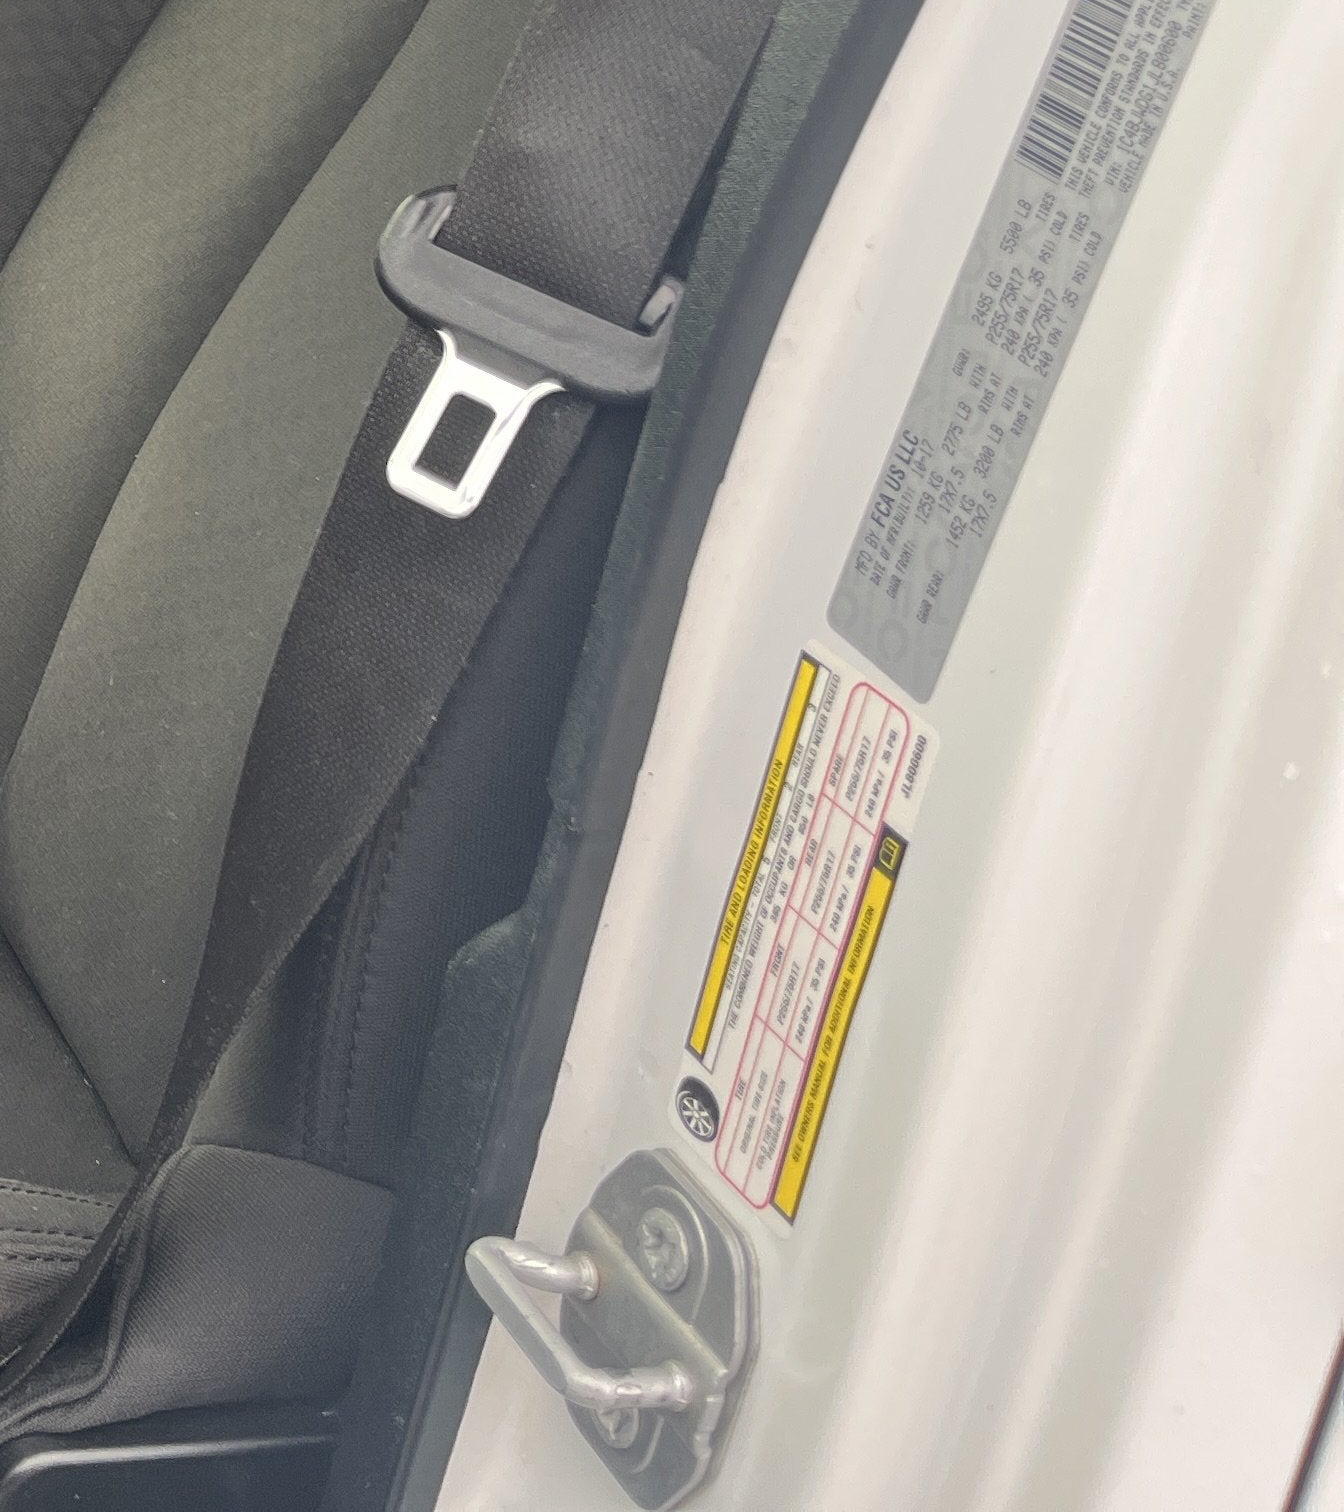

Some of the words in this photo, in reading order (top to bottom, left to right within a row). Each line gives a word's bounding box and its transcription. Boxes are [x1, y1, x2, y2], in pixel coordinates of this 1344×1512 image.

[1115, 51, 1131, 67] TO
[1121, 29, 1140, 51] ALL
[1093, 68, 1124, 120] CONFORMS
[1115, 17, 1183, 156] 1C4BJWDG1JL800600
[1077, 166, 1100, 201] THEFT
[1091, 104, 1126, 168] PREVENTION
[1117, 46, 1150, 105] STANDARDS
[1141, 29, 1157, 45] IN
[1075, 120, 1102, 165] VEHICLE
[1117, 149, 1145, 195] VEHICLE
[1135, 120, 1157, 149] MADE
[1148, 103, 1164, 119] IN
[1064, 164, 1084, 192] THIS
[970, 290, 994, 327] 2495
[984, 268, 1003, 292] KG
[998, 219, 1023, 255] 5500
[1013, 196, 1032, 219] LB
[912, 490, 936, 525] 1259
[926, 468, 945, 492] KG
[940, 420, 964, 457] 2775
[954, 399, 972, 422] LB
[967, 361, 987, 390] WITH
[984, 265, 1026, 346] P255/75R17
[1034, 189, 1056, 223] TIRES
[936, 464, 966, 514] 17X7.5
[976, 387, 996, 415] RIMS
[987, 371, 1002, 388] AT
[999, 327, 1021, 356] 240
[1013, 303, 1030, 327] KPA
[1026, 265, 1046, 289] 35
[1048, 208, 1069, 238] COLD
[944, 513, 968, 550] 1452
[957, 491, 977, 516] KG
[971, 442, 996, 480] 3200
[986, 421, 1005, 445] LB
[999, 383, 1019, 412] WITH
[1017, 286, 1060, 368] P255/75R17
[1068, 209, 1090, 244] TIRES
[968, 487, 998, 538] 17X7.5
[1009, 409, 1029, 438] RIMS
[1020, 393, 1035, 411] AT
[1032, 349, 1054, 378] 240
[1046, 325, 1063, 348] KPA
[1060, 286, 1080, 310] 35
[1082, 228, 1103, 258] COLD
[893, 427, 920, 466] LLC
[883, 462, 906, 493] US
[868, 559, 886, 587] DATE
[878, 544, 892, 561] OF
[910, 436, 936, 479] 10-17
[869, 488, 895, 529] FCA
[863, 527, 881, 550] BY
[821, 671, 841, 714] EXCEED
[811, 711, 829, 748] NEVER
[799, 745, 818, 790] SHOULD
[828, 751, 844, 788] SPARE
[788, 786, 805, 825] CARGO
[719, 914, 734, 948] TIRE
[728, 889, 742, 919] AND
[736, 835, 759, 894] LOADING
[752, 756, 784, 841] INFORMATION
[735, 907, 753, 955] CAPACITY
[751, 869, 765, 900] TOTAL
[769, 811, 783, 844] FRONT
[791, 741, 804, 769] REAR
[782, 822, 795, 846] AND
[804, 836, 818, 867] REAR
[764, 843, 788, 907] OCCUPANTS
[786, 853, 796, 872] OR
[759, 903, 769, 921] OF
[748, 918, 764, 961] WEIGHT
[769, 941, 785, 979] FRONT
[733, 956, 753, 1012] COMBINED
[727, 1007, 738, 1032] THE
[808, 1055, 826, 1102] MANUAL
[821, 1031, 834, 1058] FOR
[734, 1074, 746, 1103] TIRE
